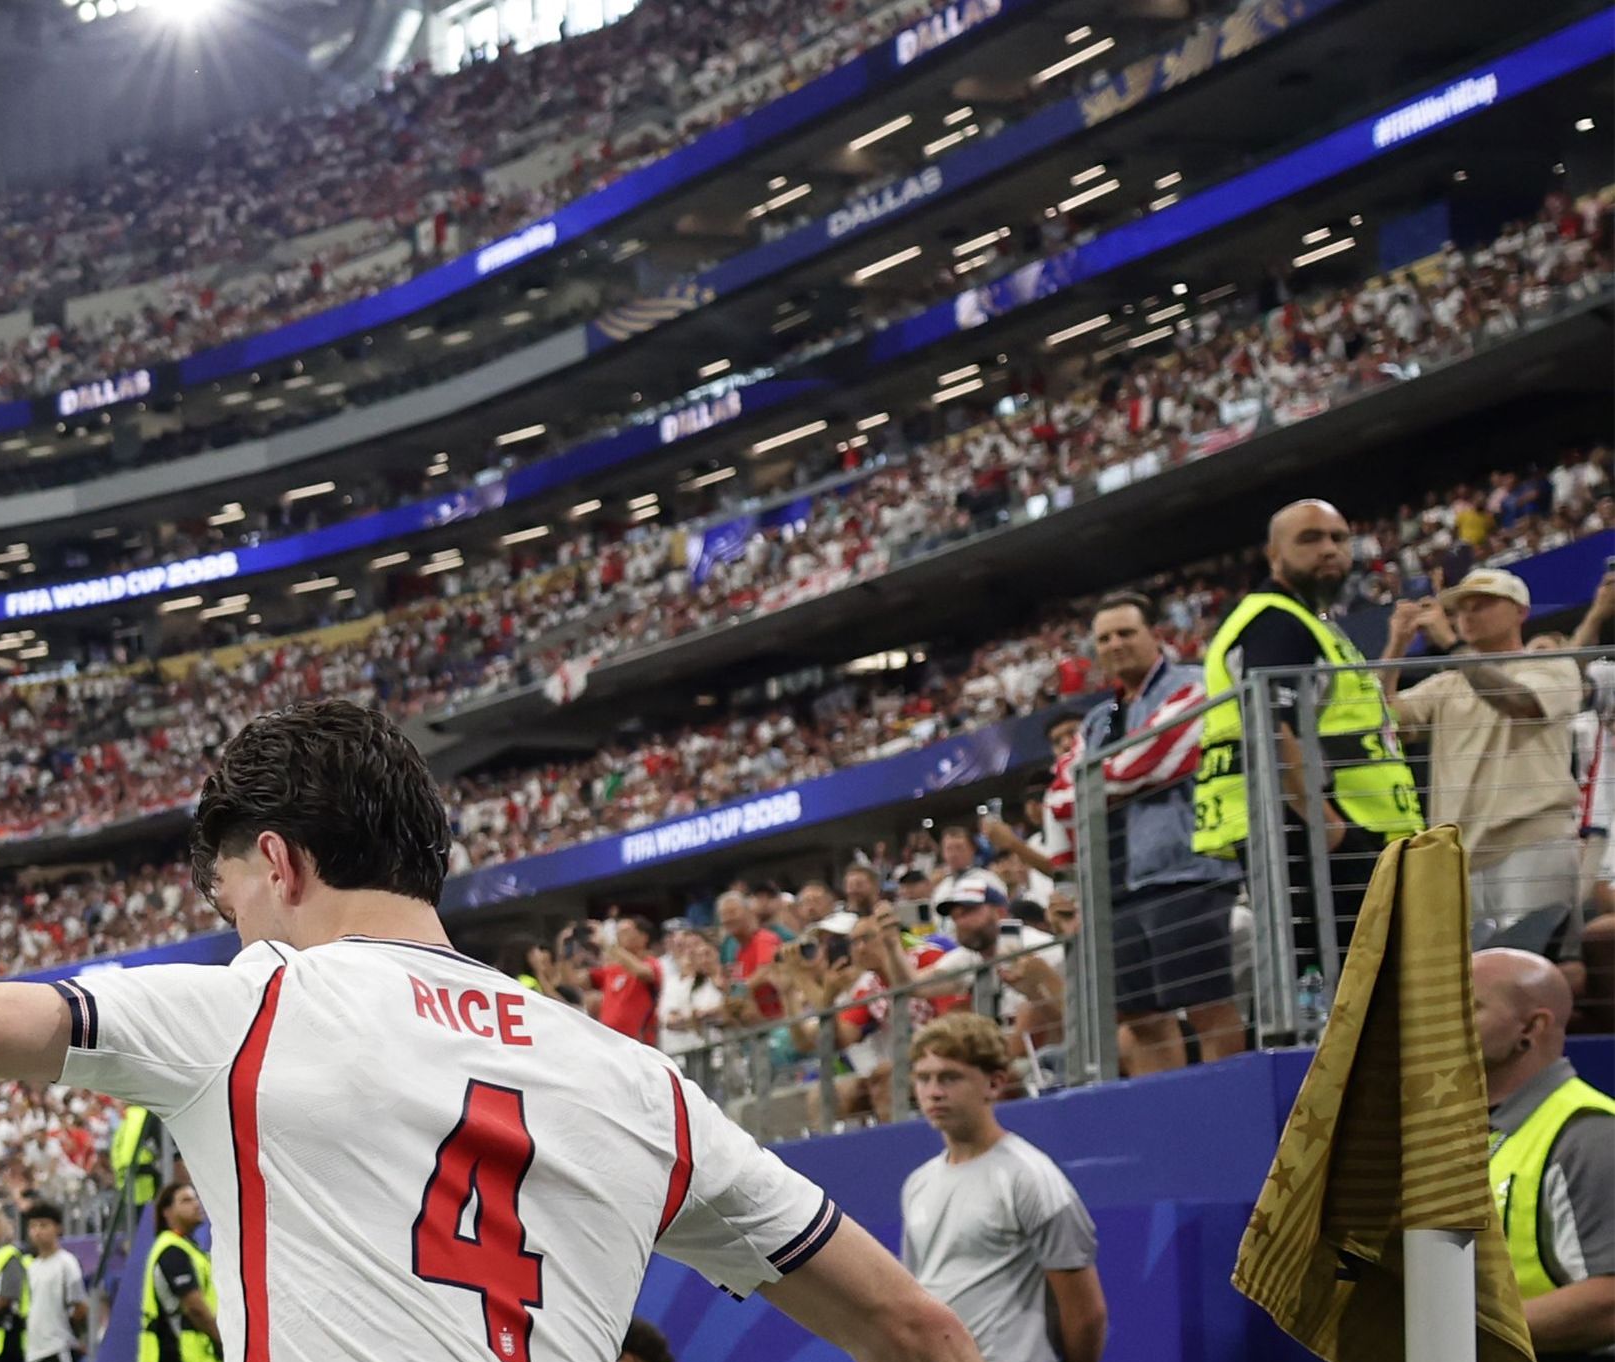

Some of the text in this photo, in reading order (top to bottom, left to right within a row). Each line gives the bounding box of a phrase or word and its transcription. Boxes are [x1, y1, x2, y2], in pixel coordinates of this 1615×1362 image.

[827, 167, 942, 238] DALLAS
[60, 371, 151, 415] DALLAS
[659, 391, 742, 445] DALLAS
[5, 551, 239, 617] FIFA WORLD CUP 2026
[623, 790, 802, 865] FIFA WORLD CUP 2026
[408, 973, 534, 1047] RICE
